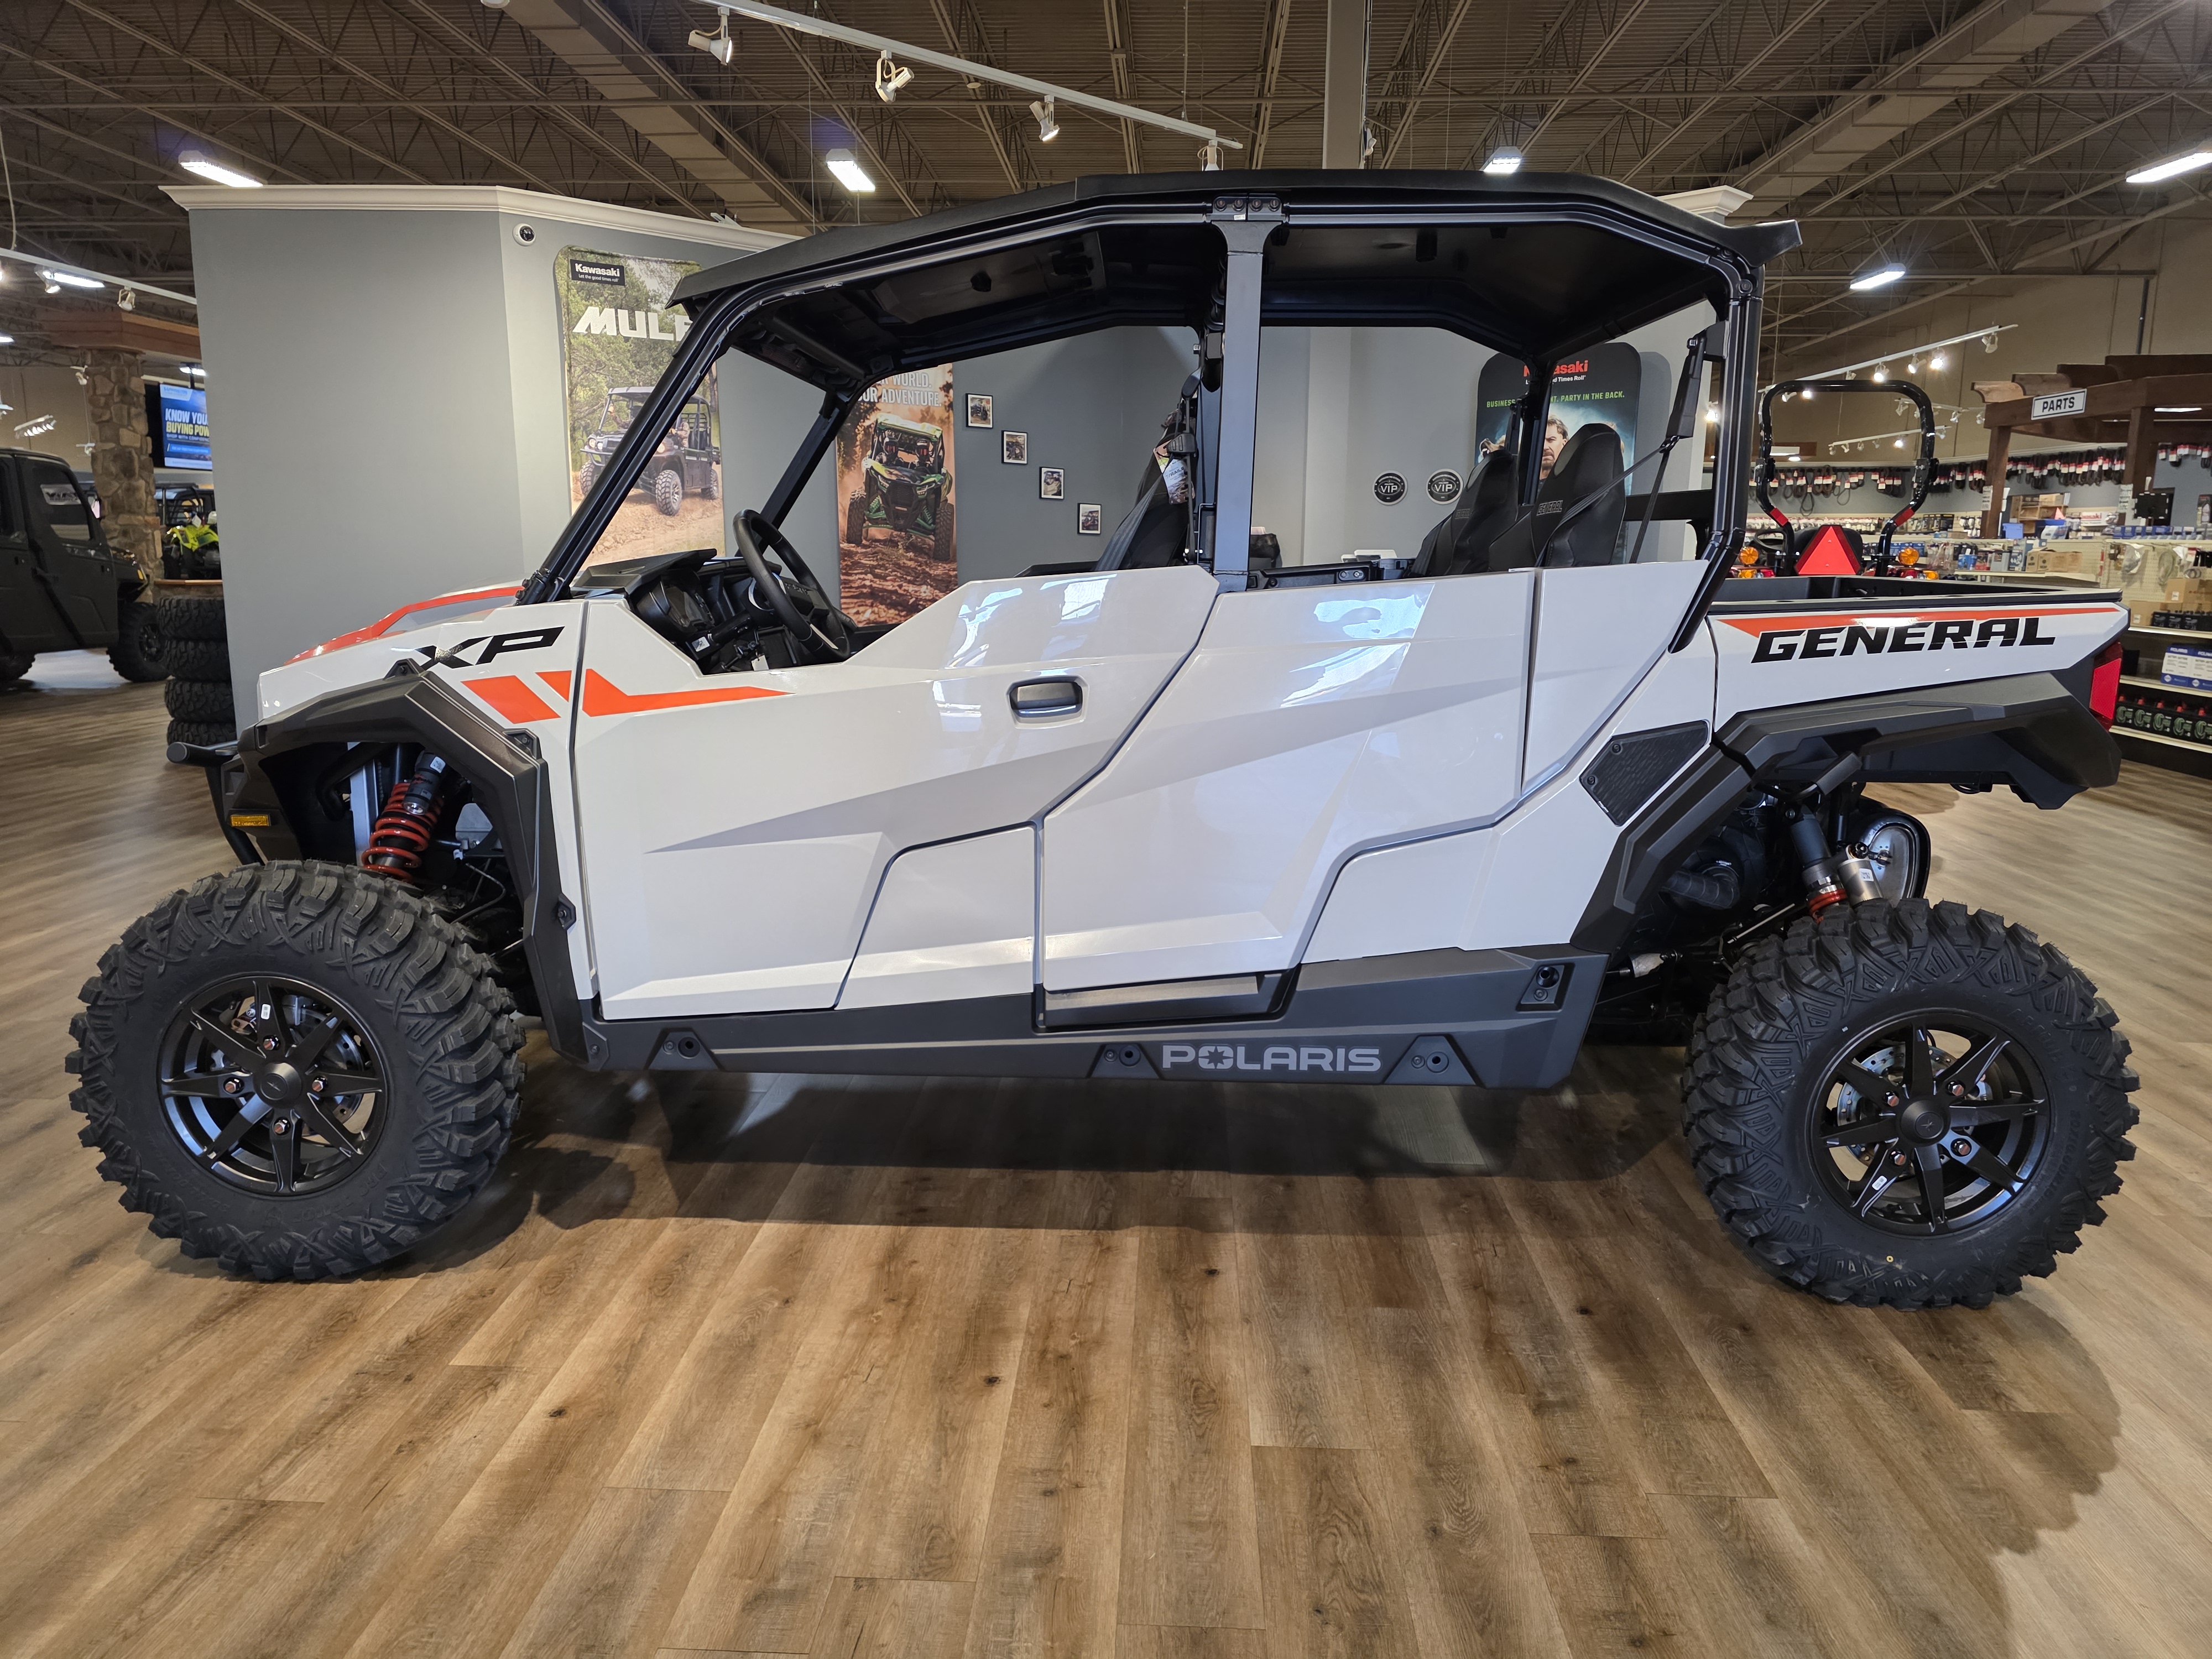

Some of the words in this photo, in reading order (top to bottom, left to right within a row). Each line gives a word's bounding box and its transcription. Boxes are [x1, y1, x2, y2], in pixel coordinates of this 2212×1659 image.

[575, 263, 620, 276] Kawasaki
[893, 373, 932, 388] WORLD.
[881, 388, 942, 406] ADVENTURE.
[1486, 399, 1516, 408] BUSINESS
[1561, 394, 1581, 402] PARTY
[1605, 390, 1625, 399] BACK.
[2042, 397, 2075, 413] PARTS
[165, 408, 190, 422] KNOW
[192, 412, 208, 425] YOU
[166, 421, 193, 435] BUYING
[194, 425, 210, 437] POW
[414, 626, 566, 671] XP
[1751, 617, 2056, 664] GENERAL
[1162, 1045, 1381, 1072] POLARIS
